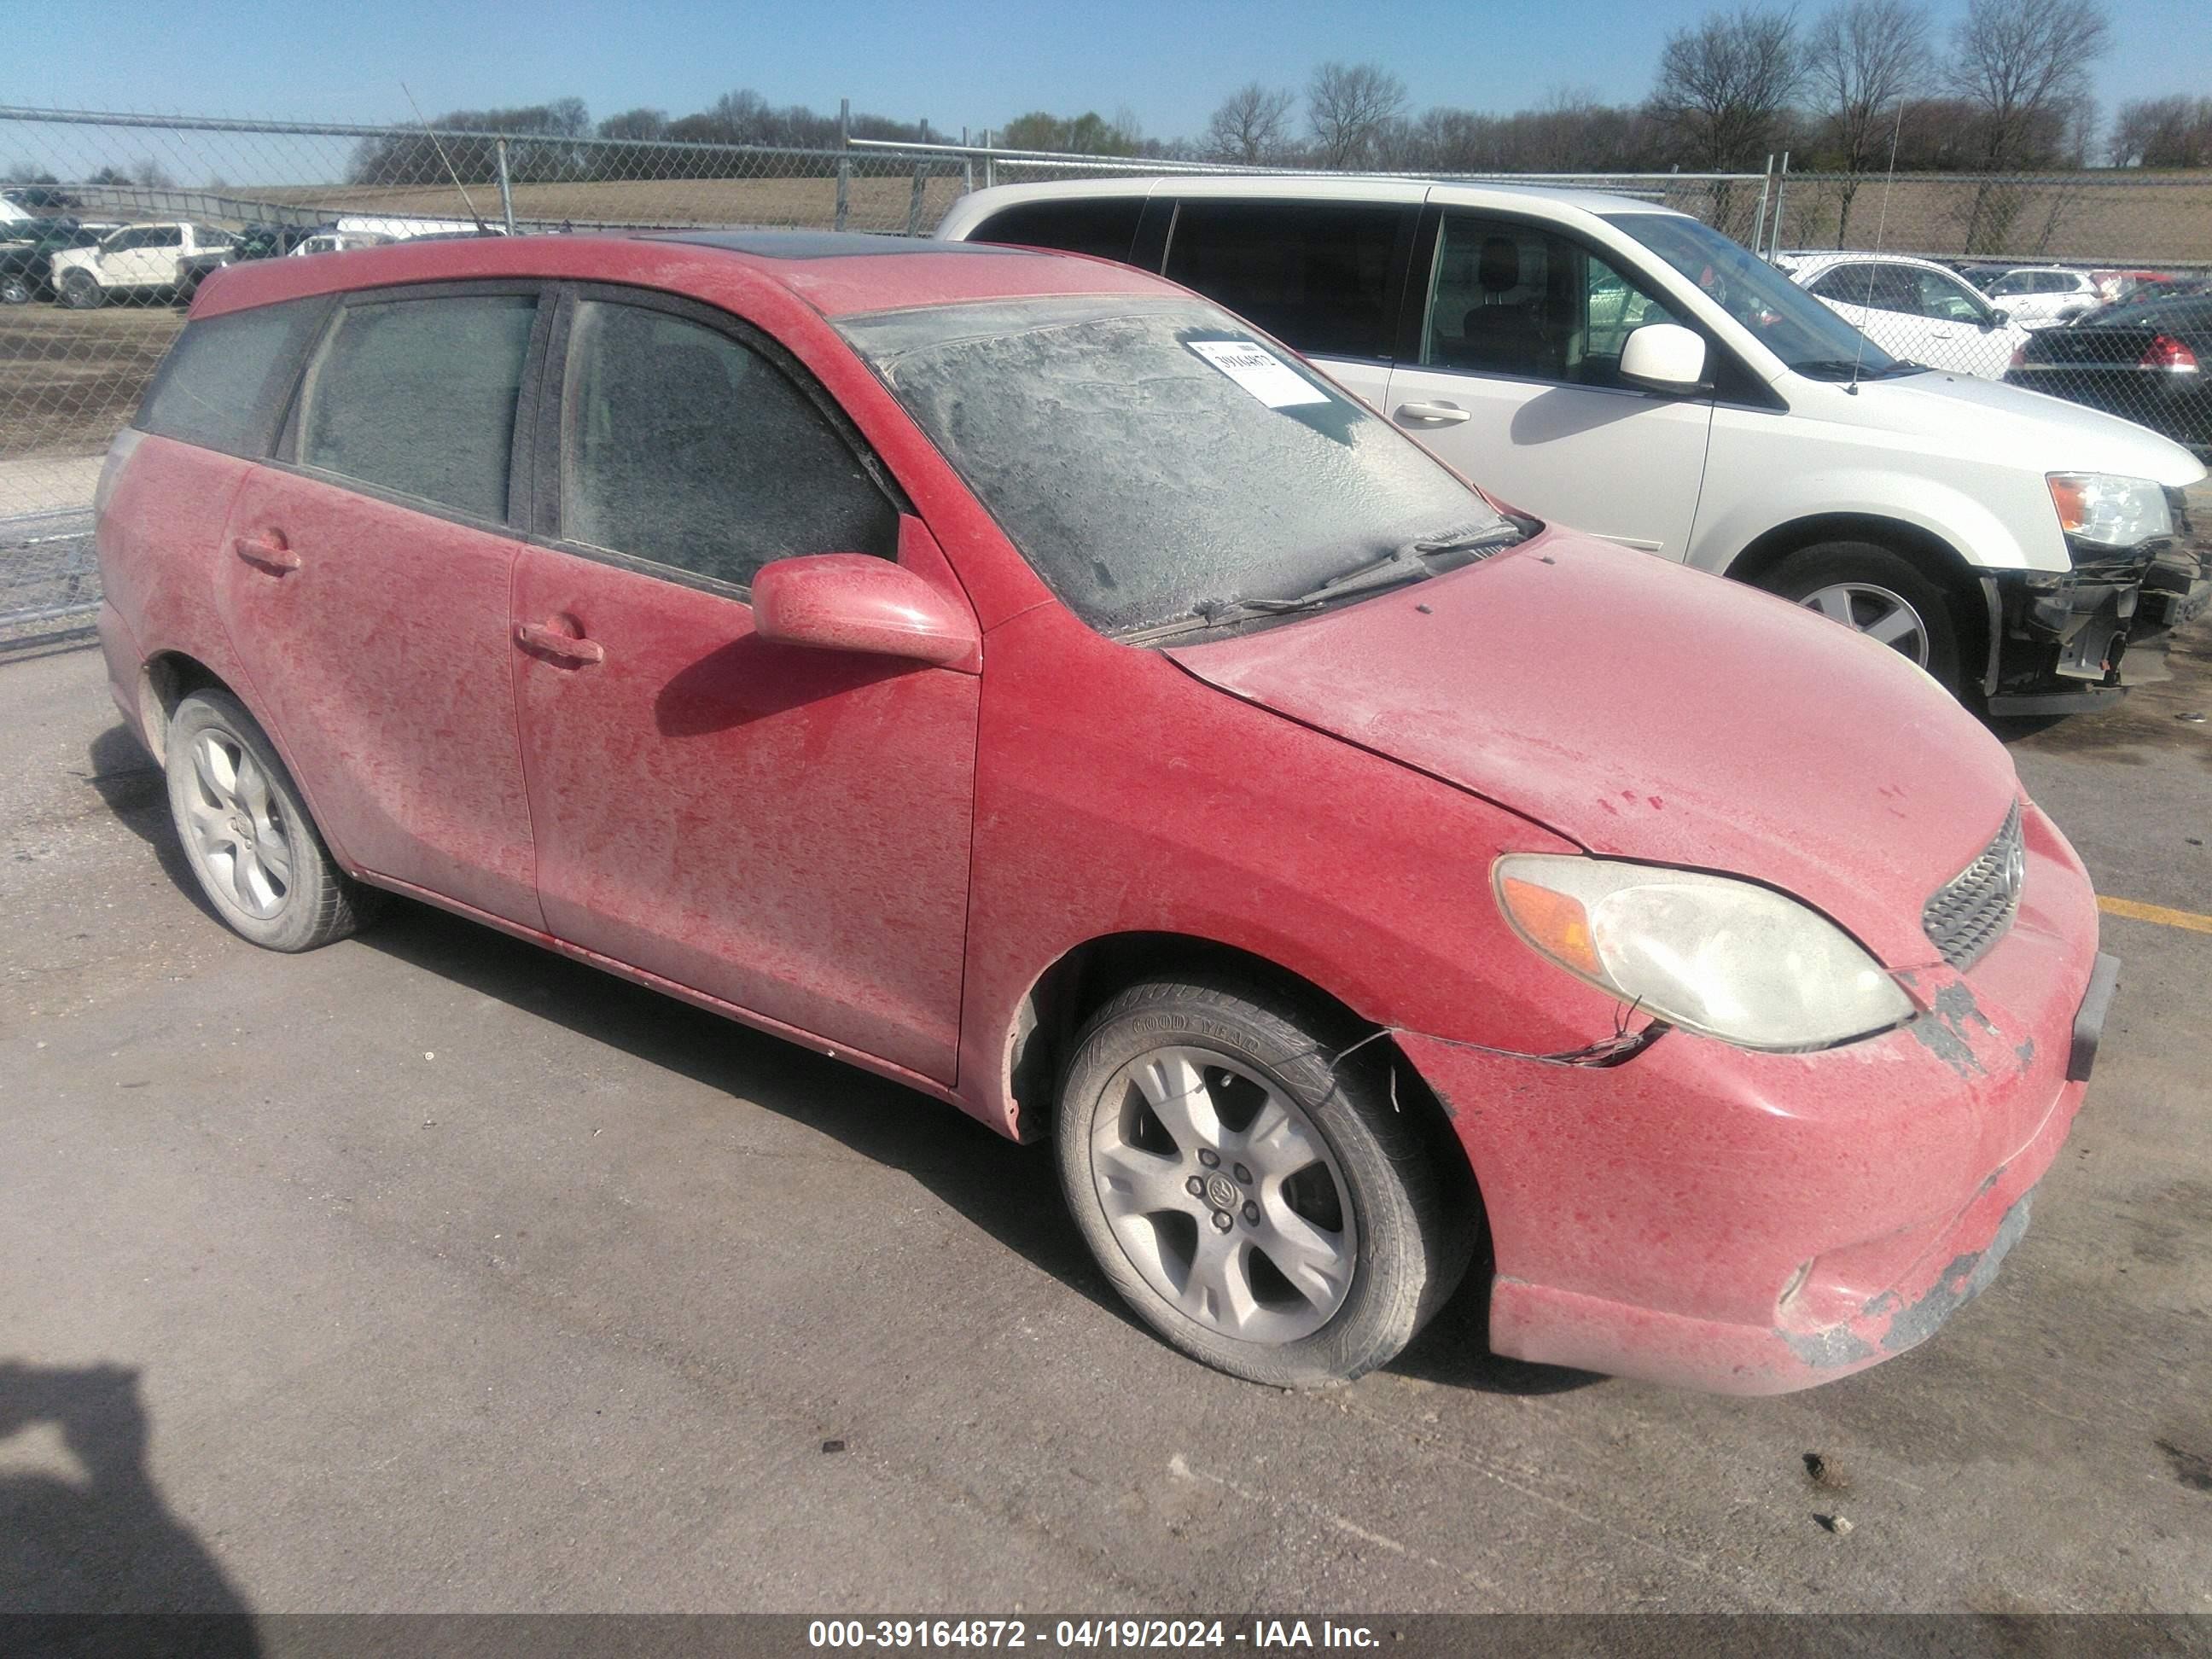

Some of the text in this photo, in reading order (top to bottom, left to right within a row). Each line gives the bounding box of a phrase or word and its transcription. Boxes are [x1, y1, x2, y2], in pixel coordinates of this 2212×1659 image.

[1215, 354, 1276, 369] 39164872
[1132, 1014, 1261, 1054] GOOD YEAR
